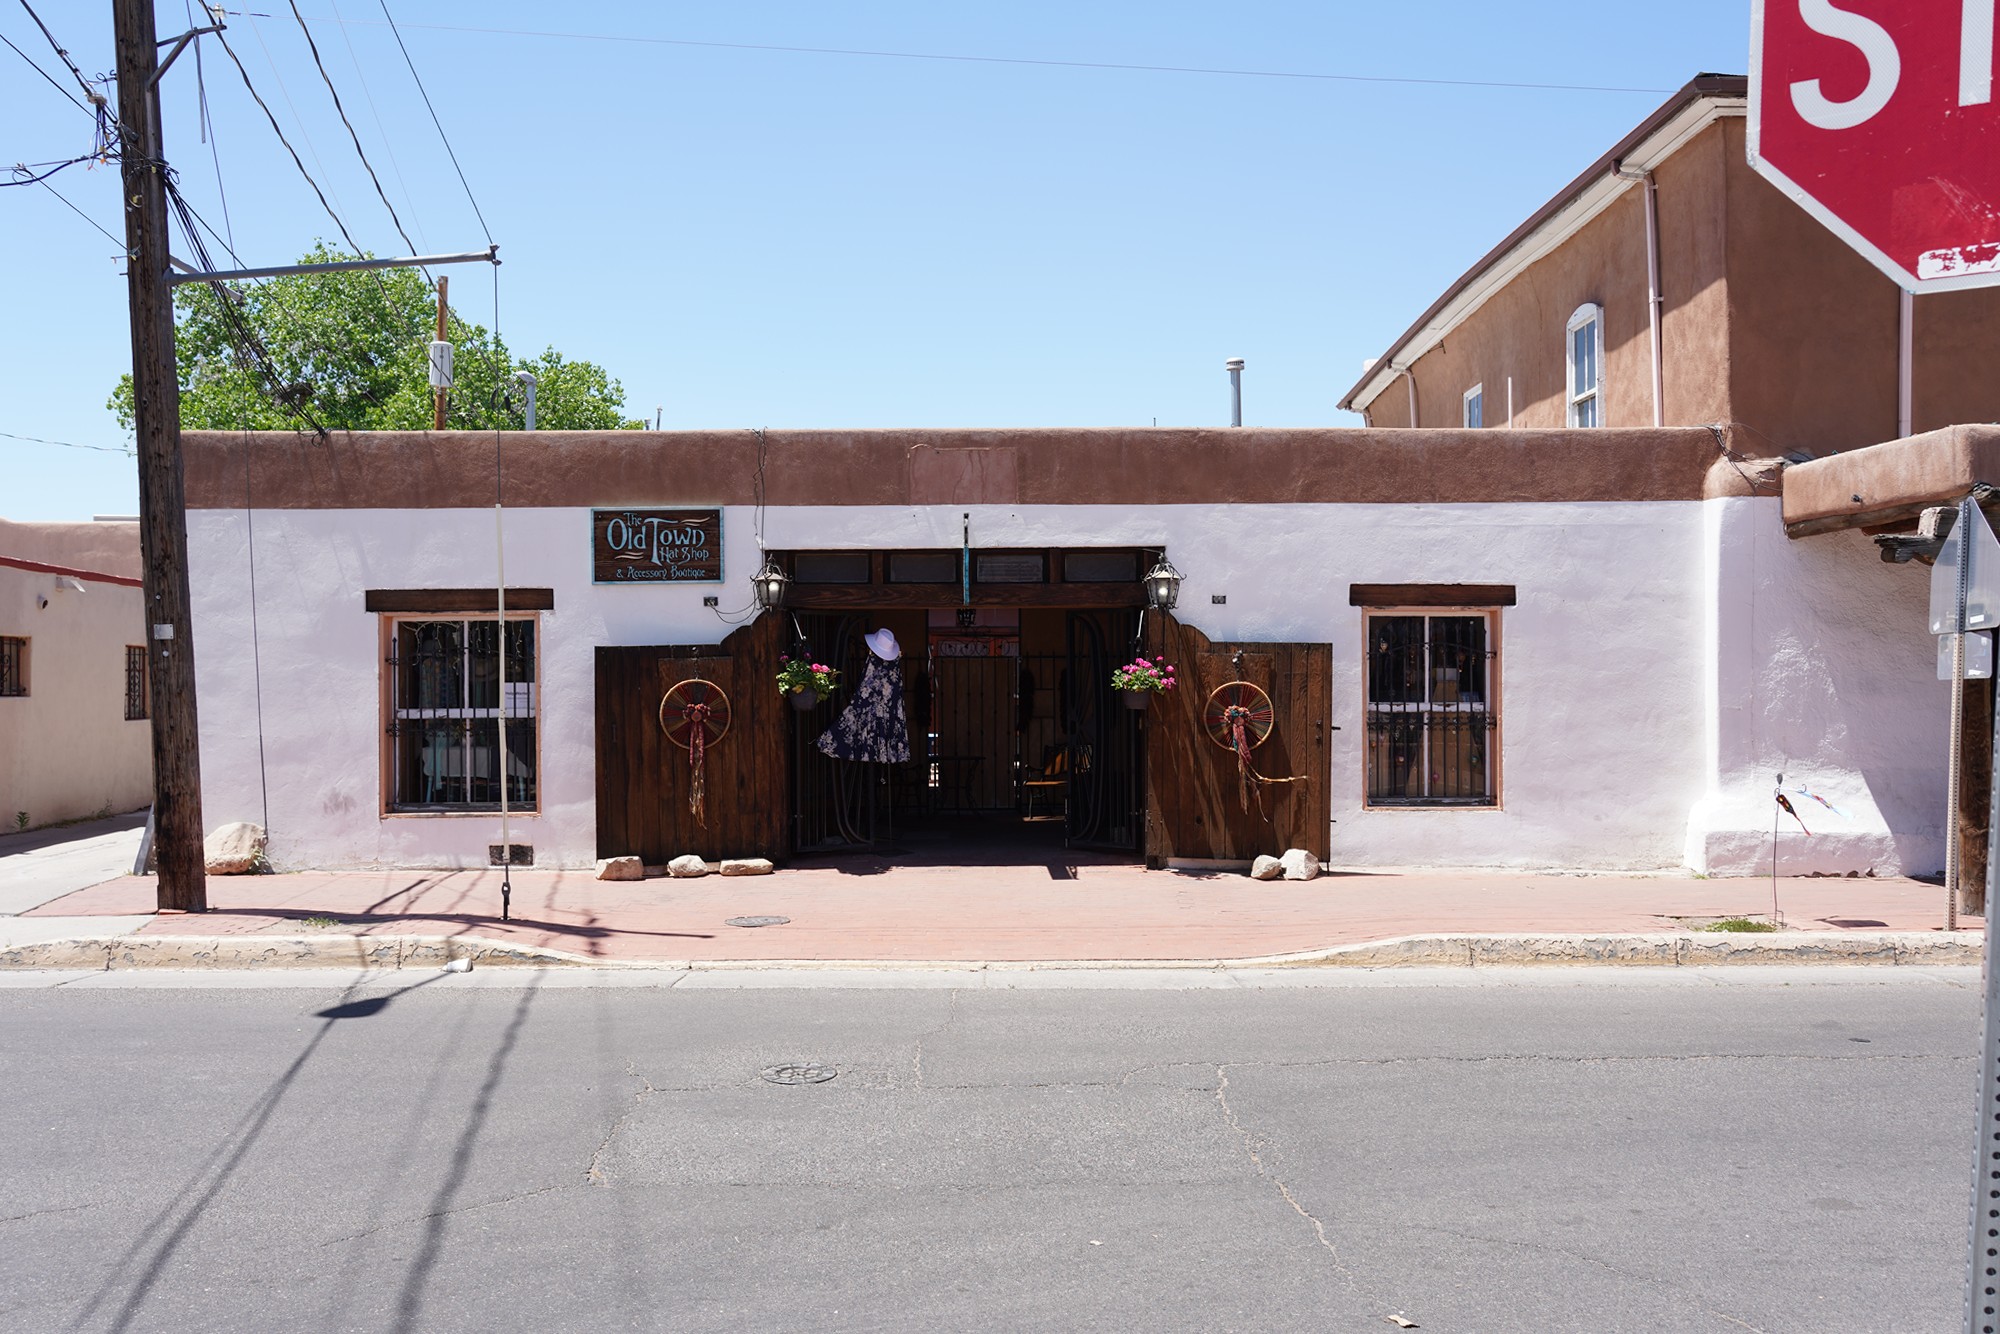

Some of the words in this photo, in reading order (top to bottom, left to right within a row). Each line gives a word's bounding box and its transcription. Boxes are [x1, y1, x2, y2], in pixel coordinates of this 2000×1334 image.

[623, 512, 642, 526] The
[607, 518, 646, 550] Old
[643, 517, 705, 566] Town
[659, 547, 678, 564] Hat
[678, 547, 709, 565] Shop
[616, 568, 624, 578] &
[627, 566, 667, 579] Accessory
[671, 565, 706, 579] Boutique
